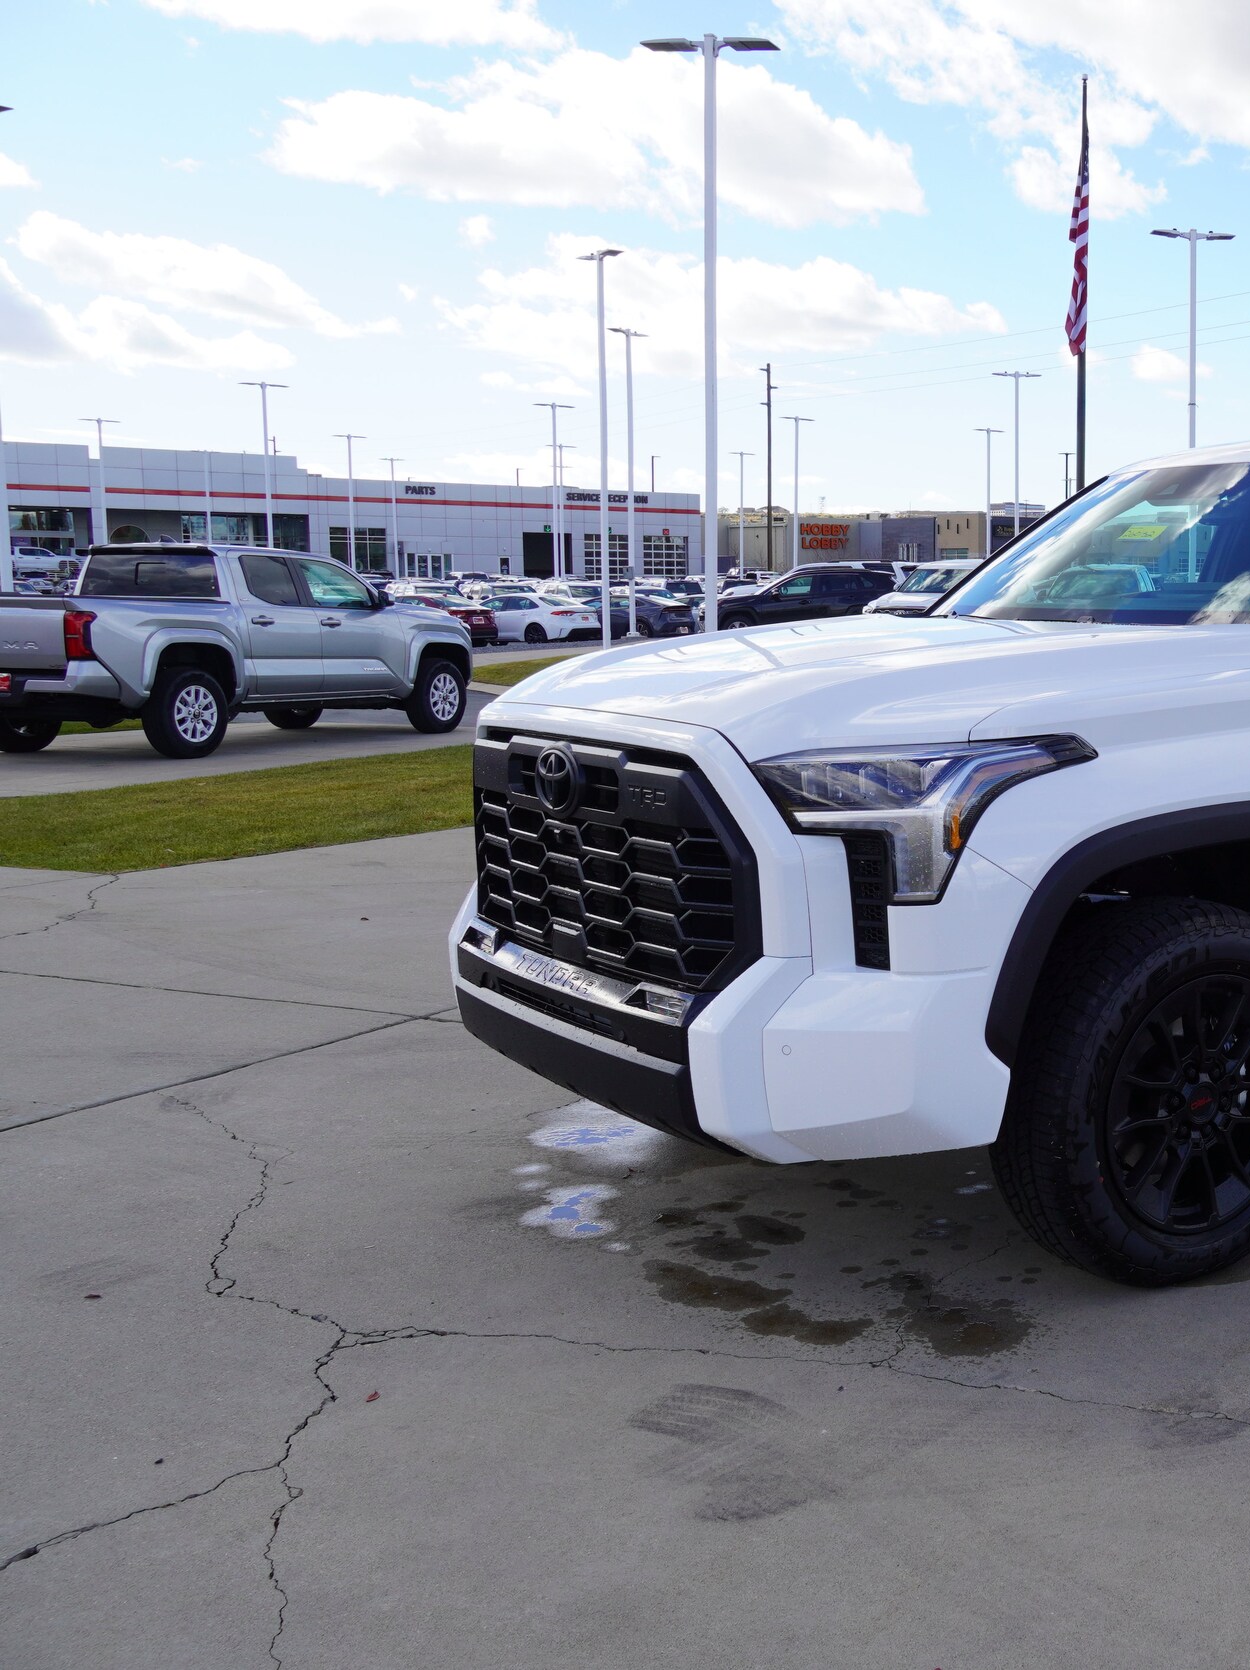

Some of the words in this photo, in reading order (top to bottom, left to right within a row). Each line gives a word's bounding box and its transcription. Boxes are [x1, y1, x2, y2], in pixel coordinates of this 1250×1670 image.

[405, 485, 436, 496] PARTS
[566, 492, 601, 503] SERVICE
[606, 494, 649, 504] ECEPION
[800, 523, 850, 536] HOBBY
[801, 537, 849, 550] LOBBY
[627, 784, 668, 809] TRD
[515, 953, 600, 996] TUNDRA
